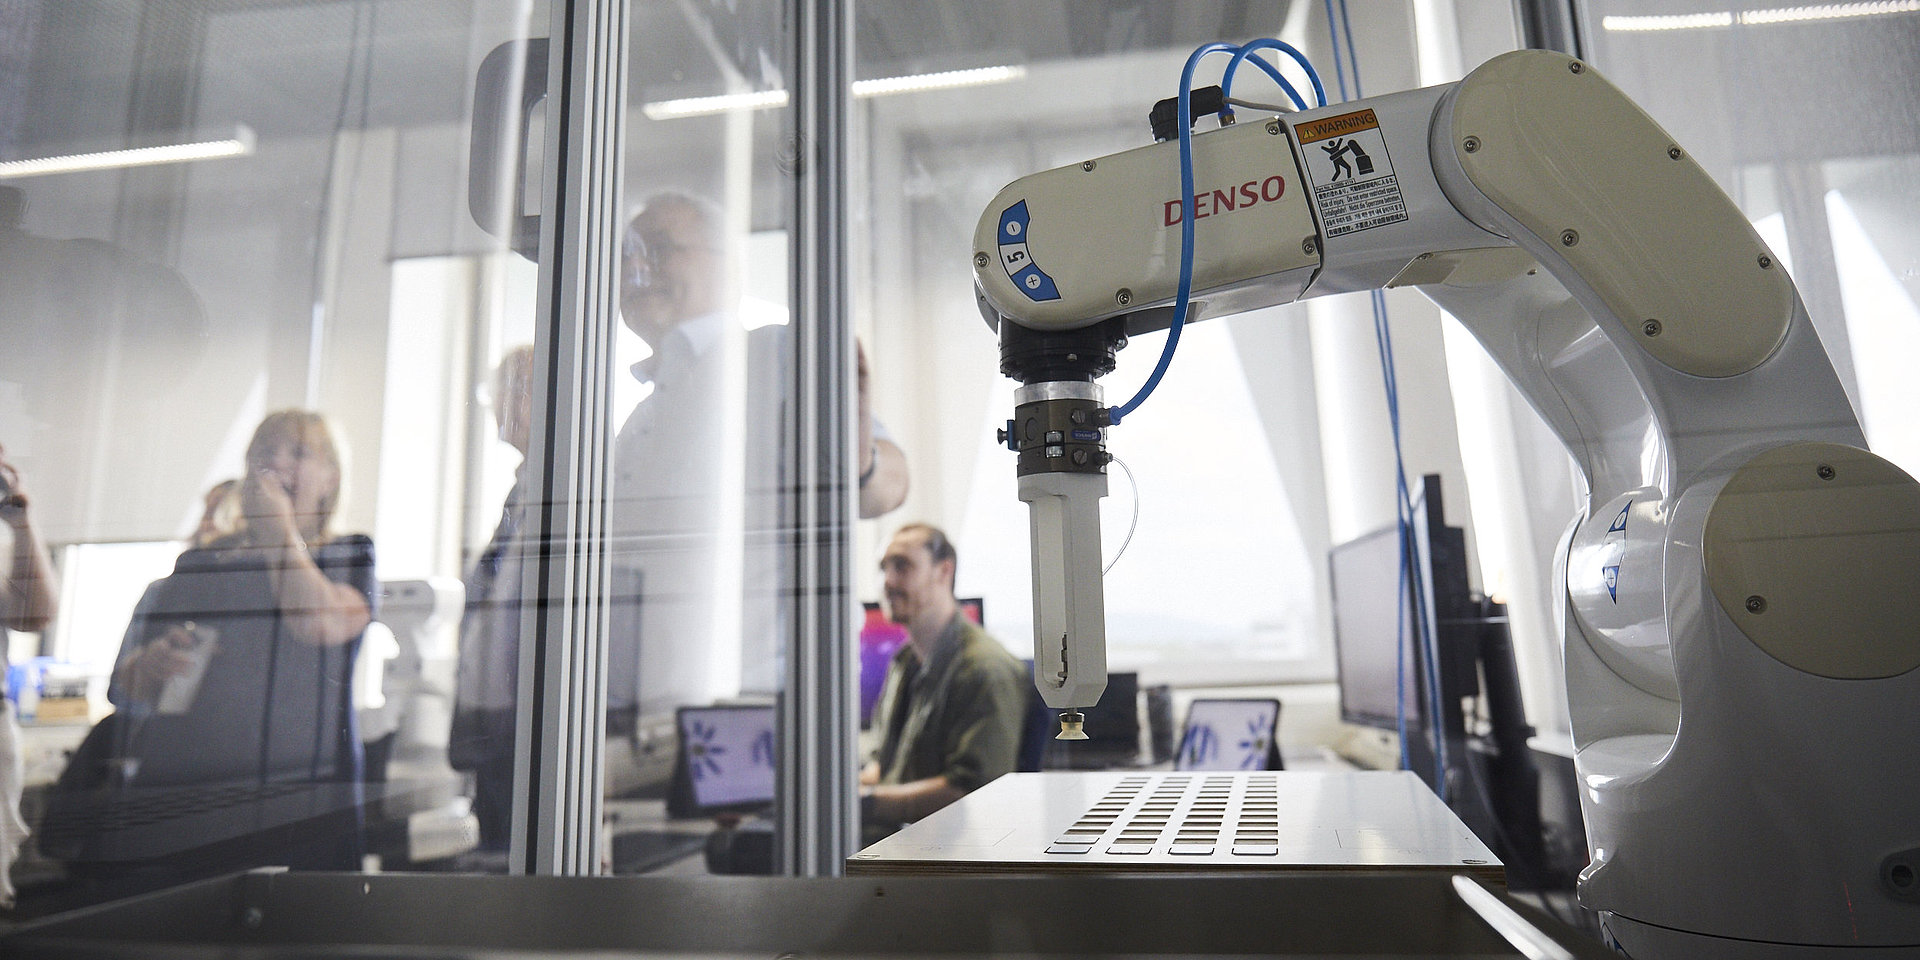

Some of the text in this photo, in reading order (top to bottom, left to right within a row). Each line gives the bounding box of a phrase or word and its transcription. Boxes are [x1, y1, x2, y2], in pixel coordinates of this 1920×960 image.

[1314, 113, 1375, 135] WARNING
[1164, 175, 1286, 227] DENSO
[1007, 250, 1025, 264] 5
